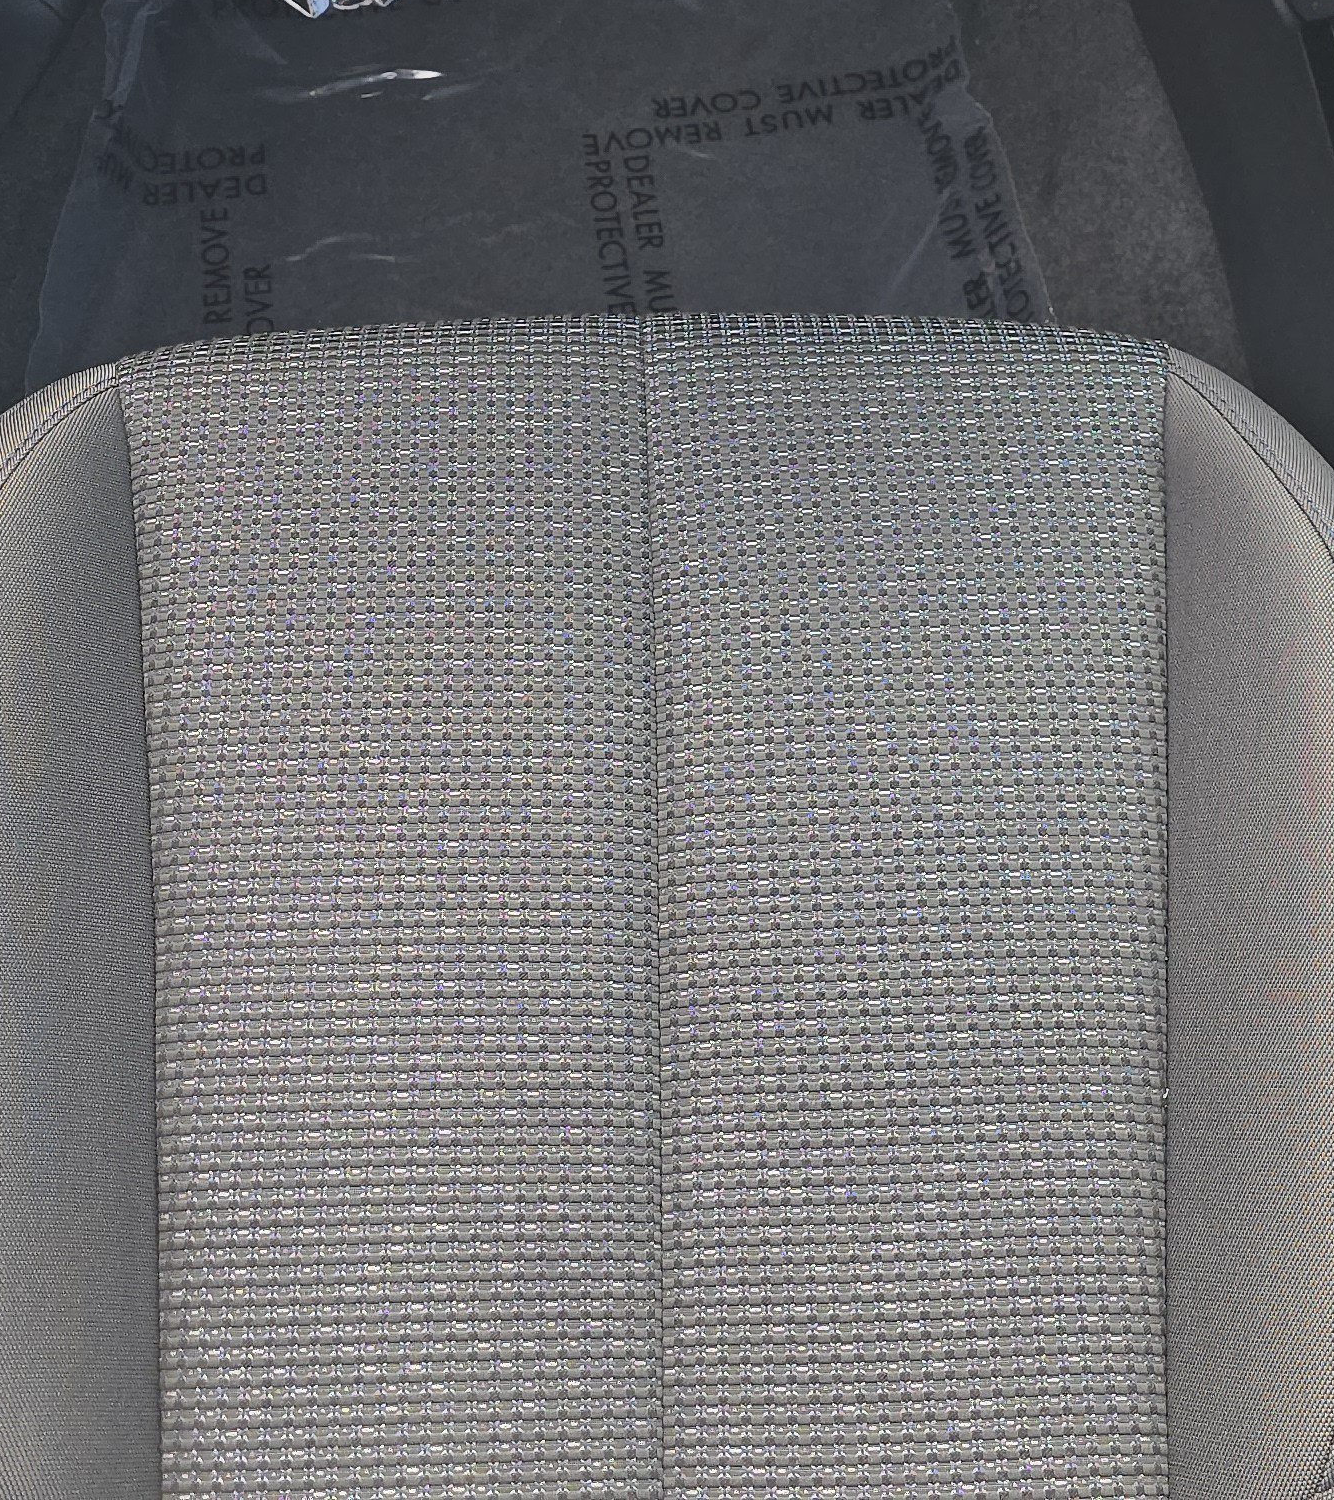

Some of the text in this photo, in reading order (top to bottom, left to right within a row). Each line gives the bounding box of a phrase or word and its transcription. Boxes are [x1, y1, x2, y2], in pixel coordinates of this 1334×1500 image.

[651, 89, 762, 119] COVER
[744, 103, 834, 137] MUST
[582, 120, 722, 157] REMOVE
[143, 173, 268, 206] DEALER
[584, 159, 637, 315] PROTECTIVE
[623, 155, 679, 313] DEALER MU
[200, 207, 233, 325] REMOVE
[243, 263, 275, 335] OVER
